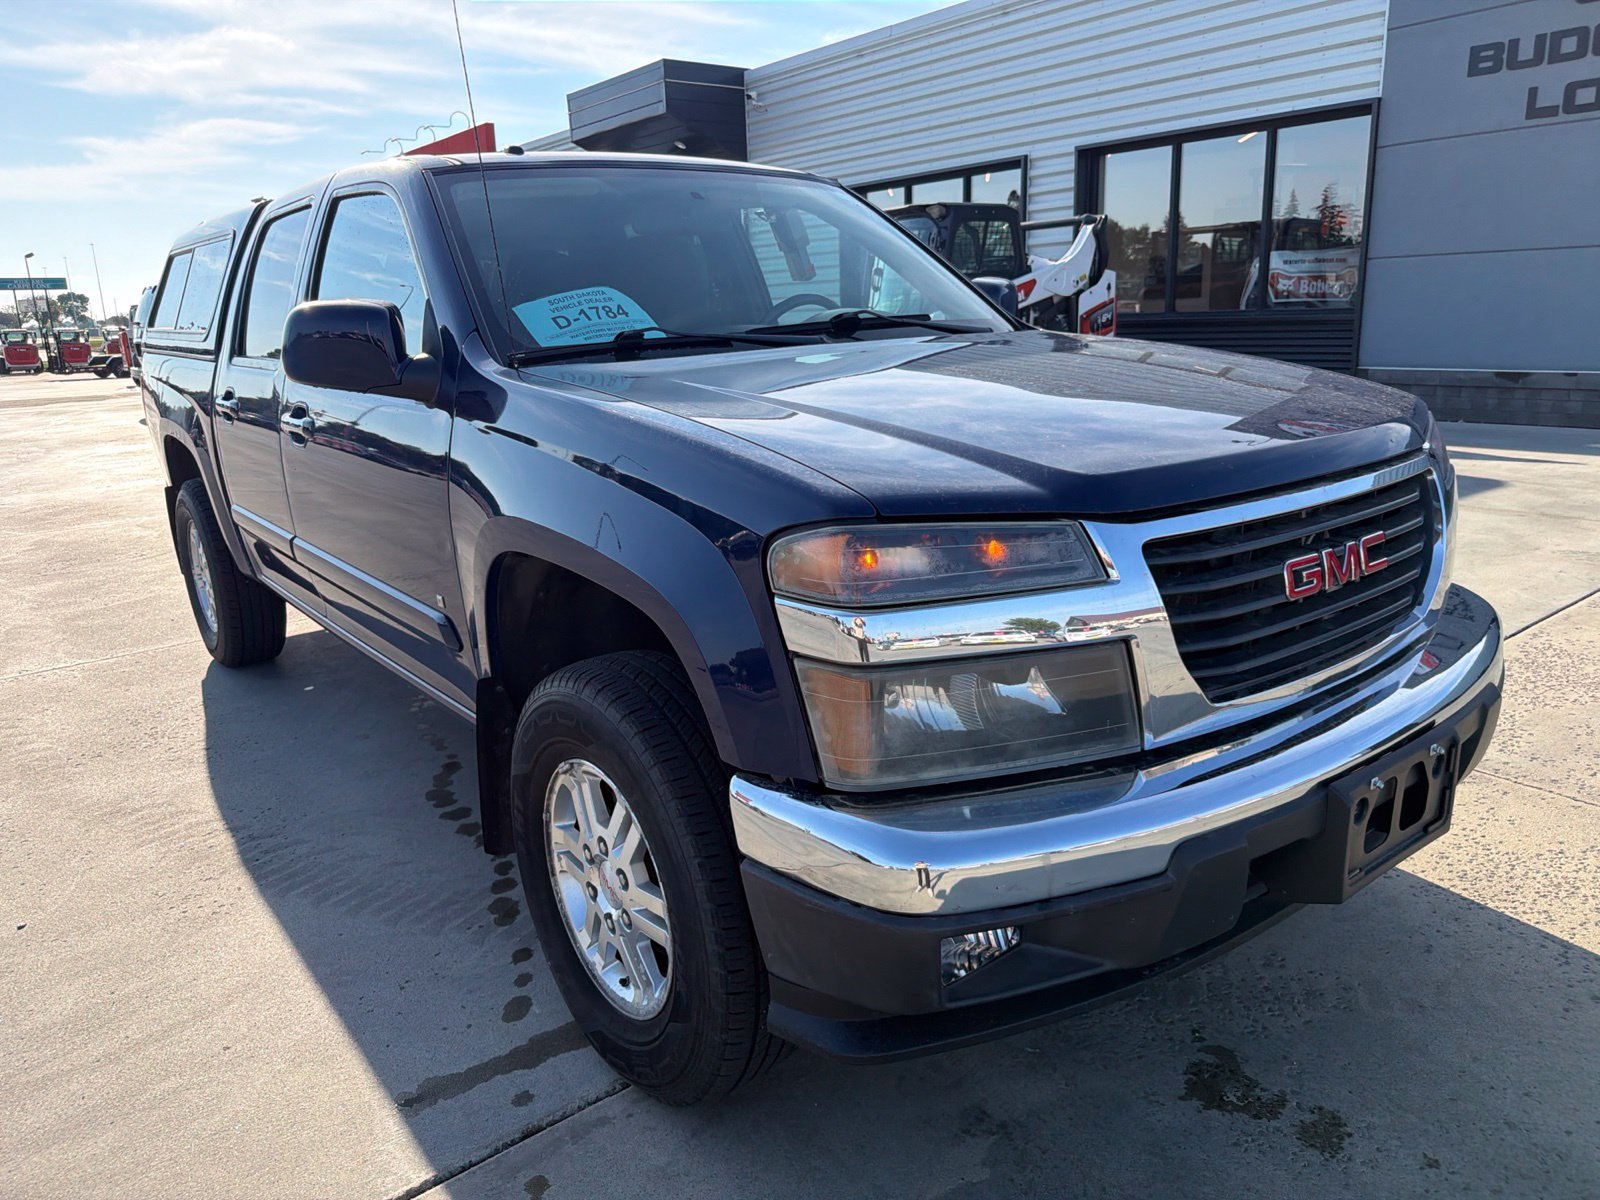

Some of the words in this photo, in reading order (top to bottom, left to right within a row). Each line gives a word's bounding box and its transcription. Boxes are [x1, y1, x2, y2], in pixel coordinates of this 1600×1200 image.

[1467, 23, 1600, 78] BUD
[548, 295, 575, 306] SOUTH
[575, 290, 607, 299] DAKOTA
[550, 299, 584, 314] VEHICLE
[584, 296, 614, 305] DEALER
[551, 304, 630, 330] D-1784
[570, 328, 606, 340] WATERTOWN
[1284, 530, 1388, 601] GMC
